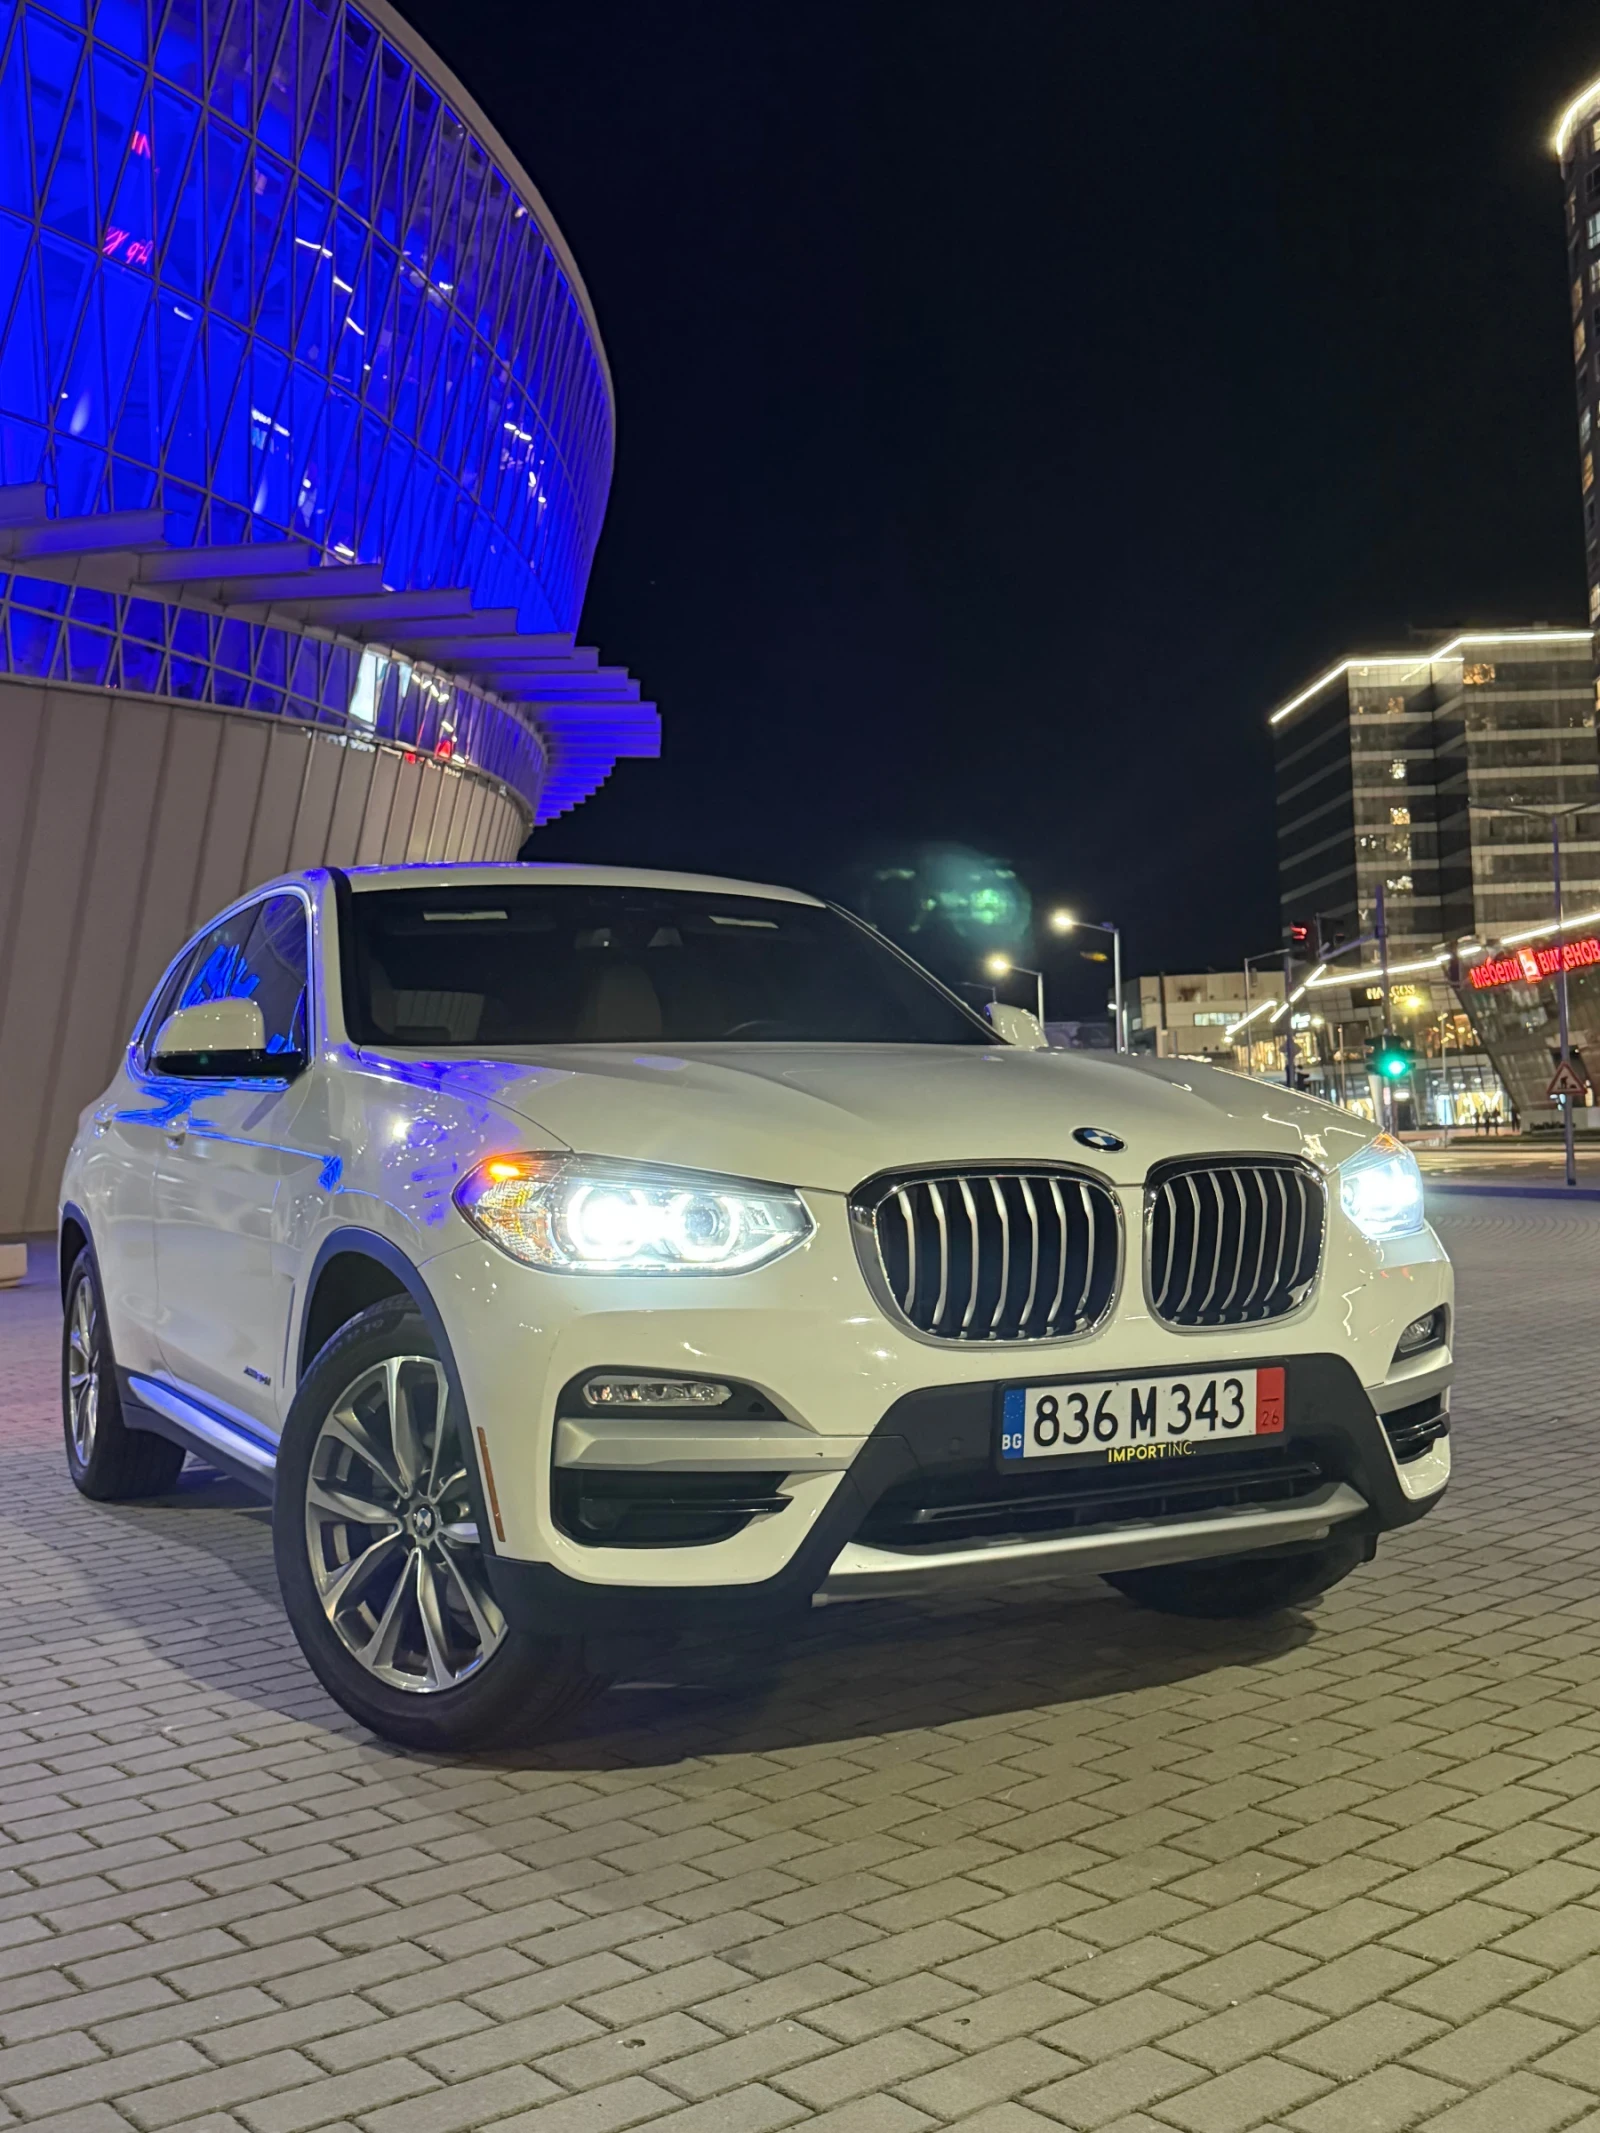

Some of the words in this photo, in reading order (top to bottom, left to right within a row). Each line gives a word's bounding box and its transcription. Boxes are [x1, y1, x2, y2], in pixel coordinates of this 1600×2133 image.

[1470, 957, 1522, 988] мебели
[1002, 1433, 1022, 1450] BG
[1033, 1390, 1119, 1447] 836
[1130, 1386, 1156, 1439] M
[1167, 1378, 1245, 1435] 343
[1261, 1408, 1280, 1426] 26
